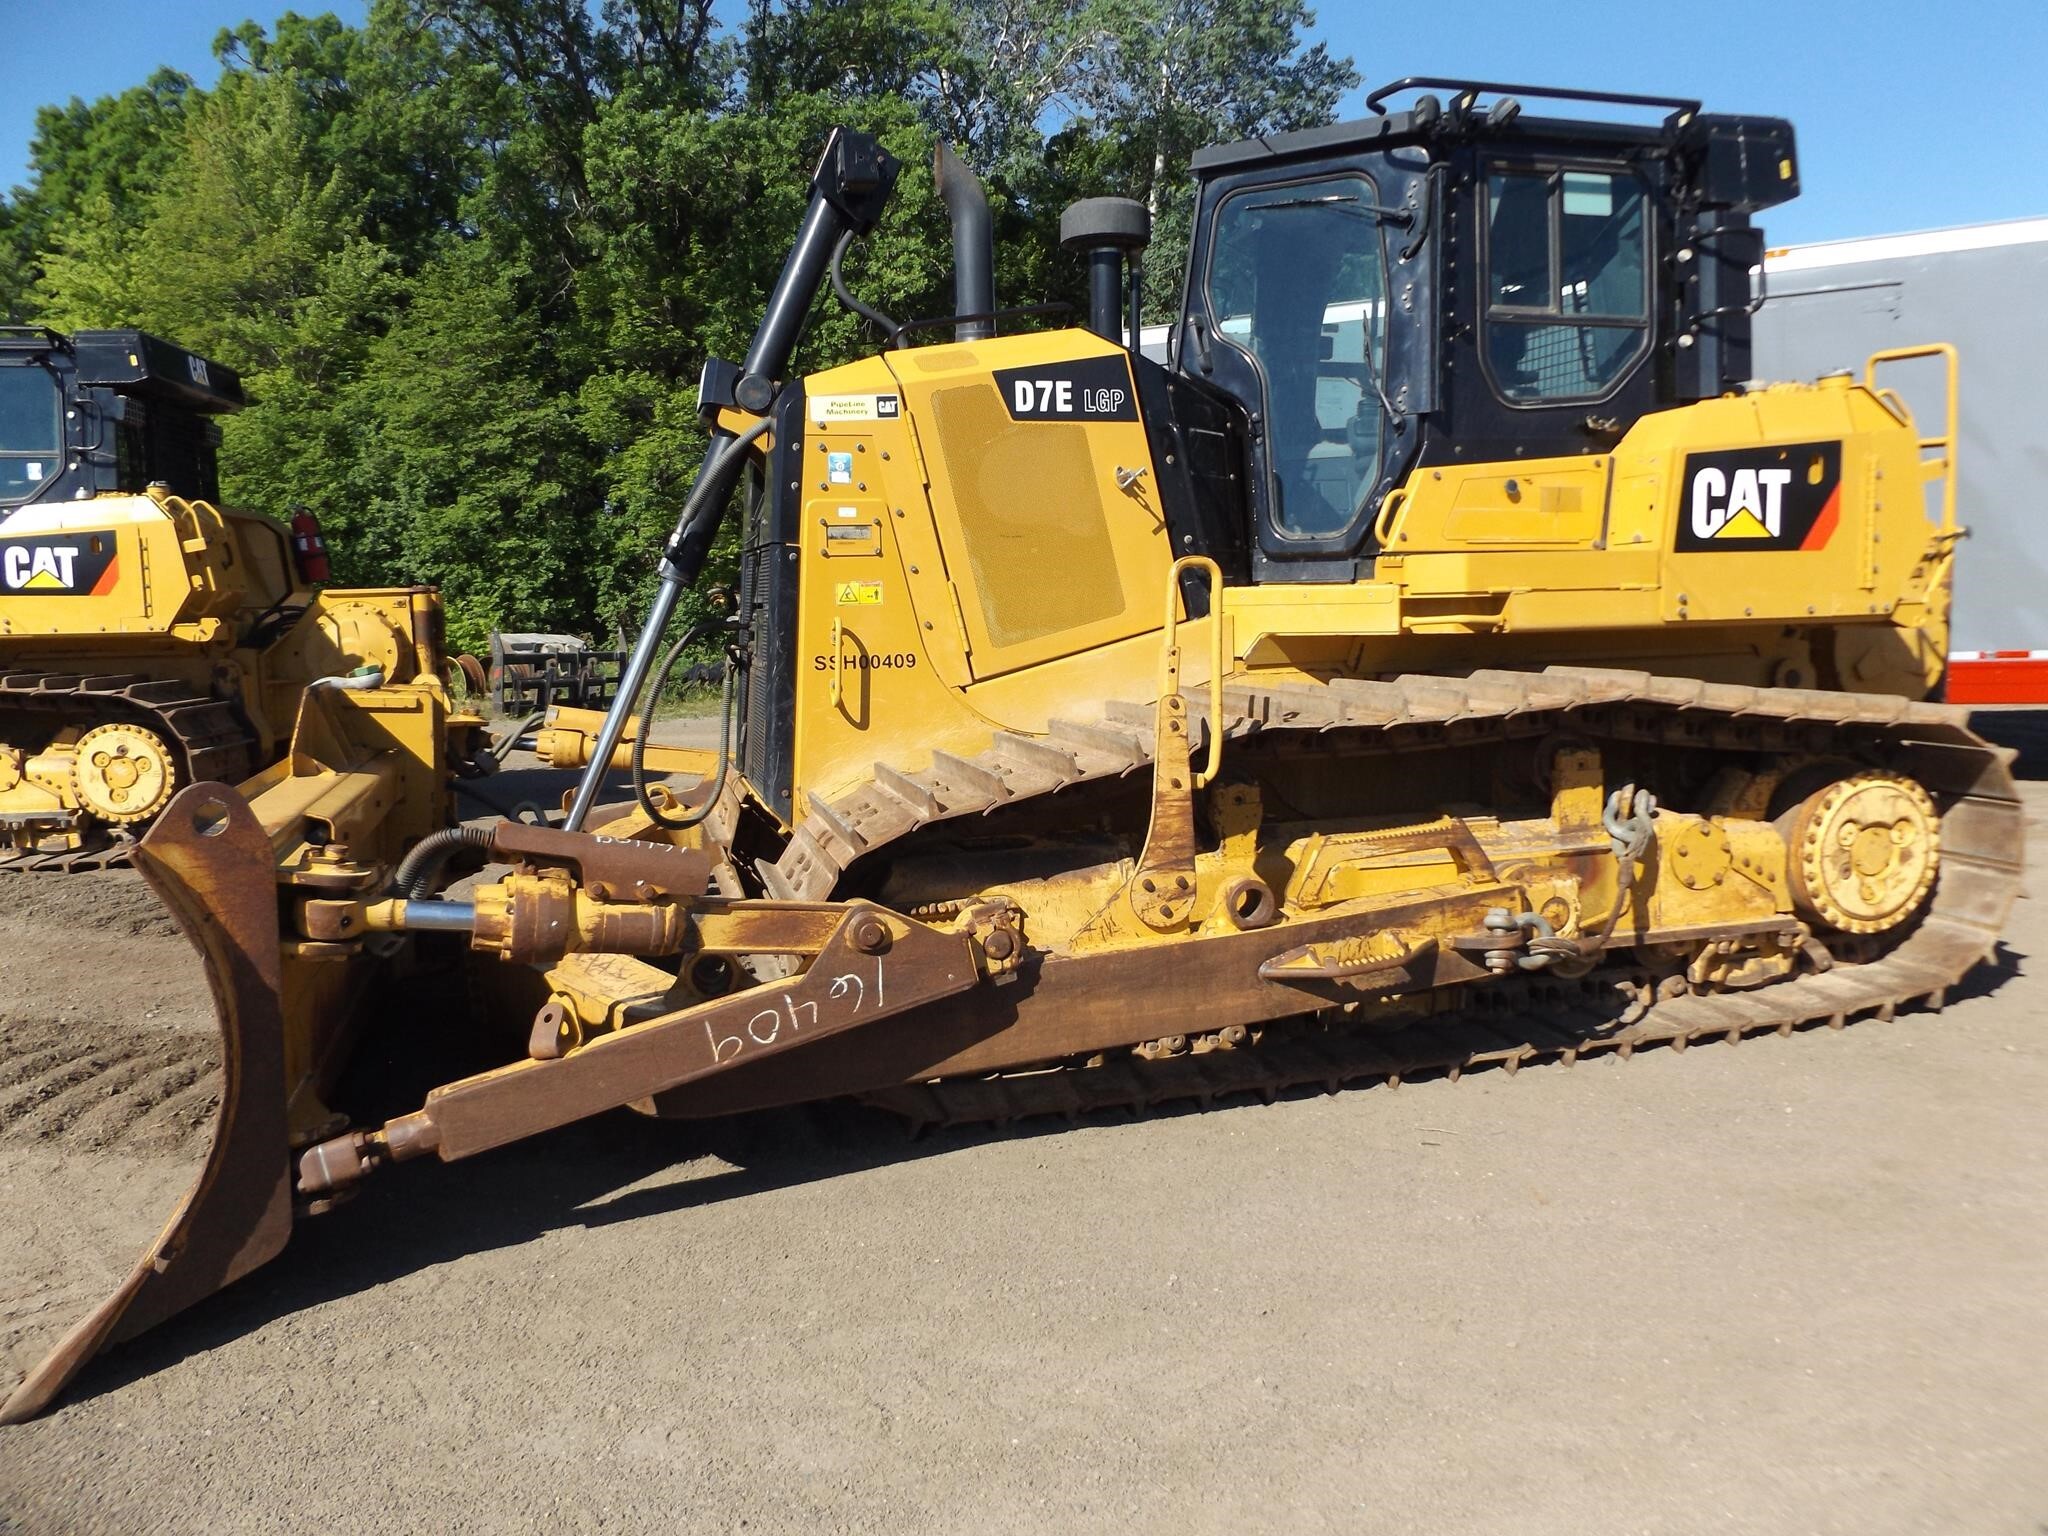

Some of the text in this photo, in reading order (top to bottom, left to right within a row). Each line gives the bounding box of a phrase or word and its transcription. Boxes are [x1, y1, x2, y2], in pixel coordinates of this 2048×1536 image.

[187, 354, 210, 386] CAT
[825, 408, 869, 416] Machinery
[877, 400, 897, 413] CAT
[1014, 380, 1125, 412] D7E LGP
[1691, 467, 1791, 539] CAT
[4, 546, 79, 589] CAT
[705, 955, 883, 1064] 16409
